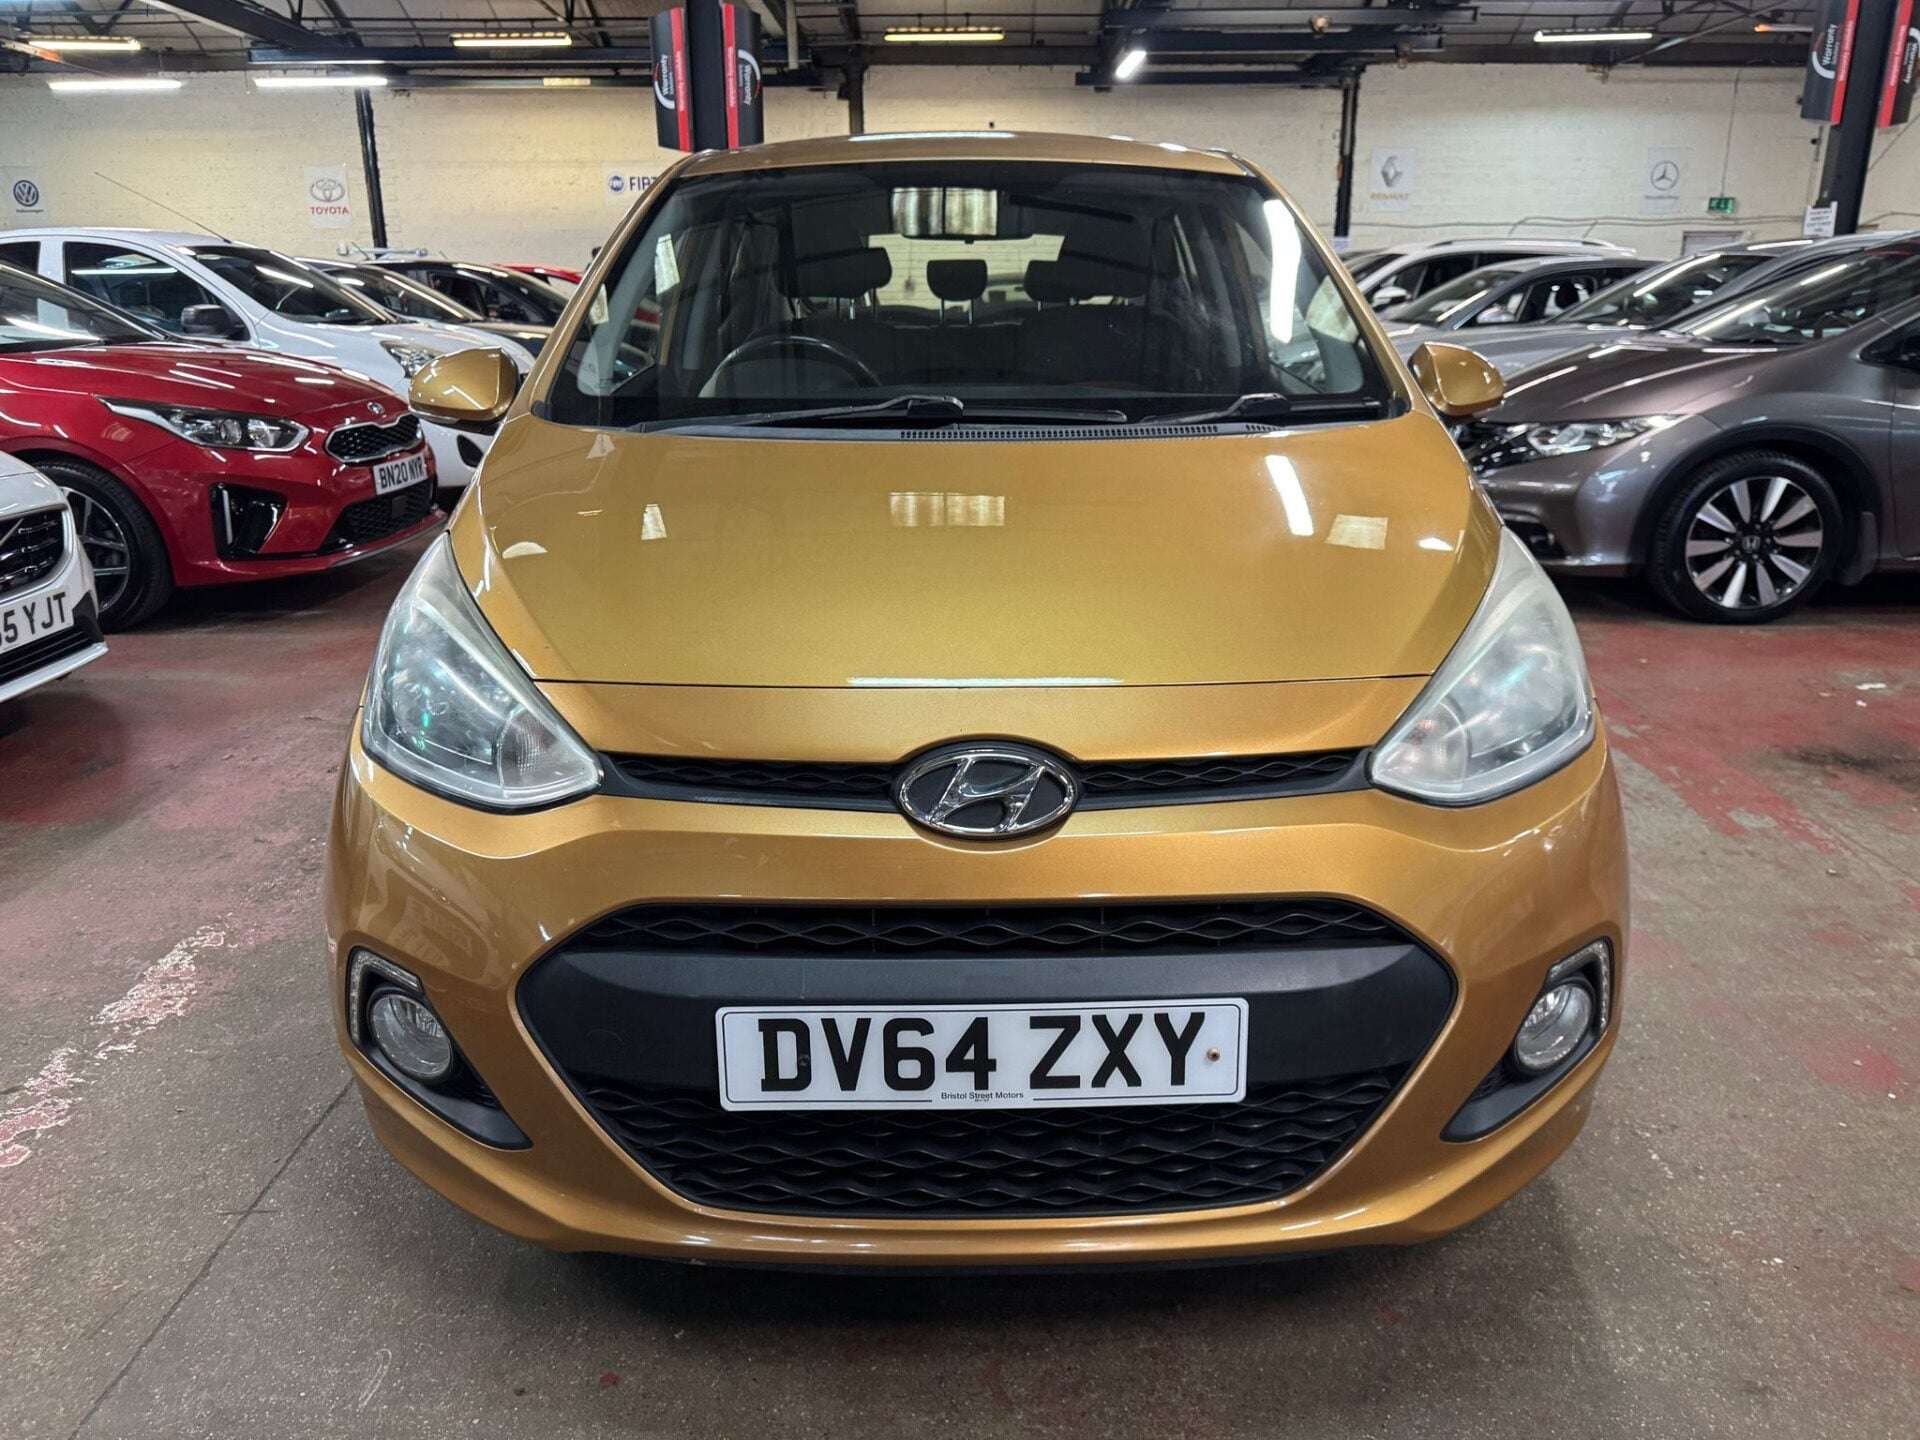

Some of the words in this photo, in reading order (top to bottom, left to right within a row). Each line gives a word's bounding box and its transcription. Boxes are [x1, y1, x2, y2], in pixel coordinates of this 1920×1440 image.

[1822, 24, 1838, 65] Warranty
[661, 54, 669, 95] Warranty
[743, 63, 752, 106] Warranty
[310, 206, 350, 215] TOYOTA
[379, 462, 408, 489] BN20
[0, 609, 18, 647] 5
[22, 591, 66, 635] YJT
[758, 1016, 997, 1092] DV64
[1029, 1012, 1206, 1089] ZXY
[940, 1091, 968, 1100] Bristol
[969, 1091, 993, 1100] Street
[995, 1091, 1024, 1100] Motors
